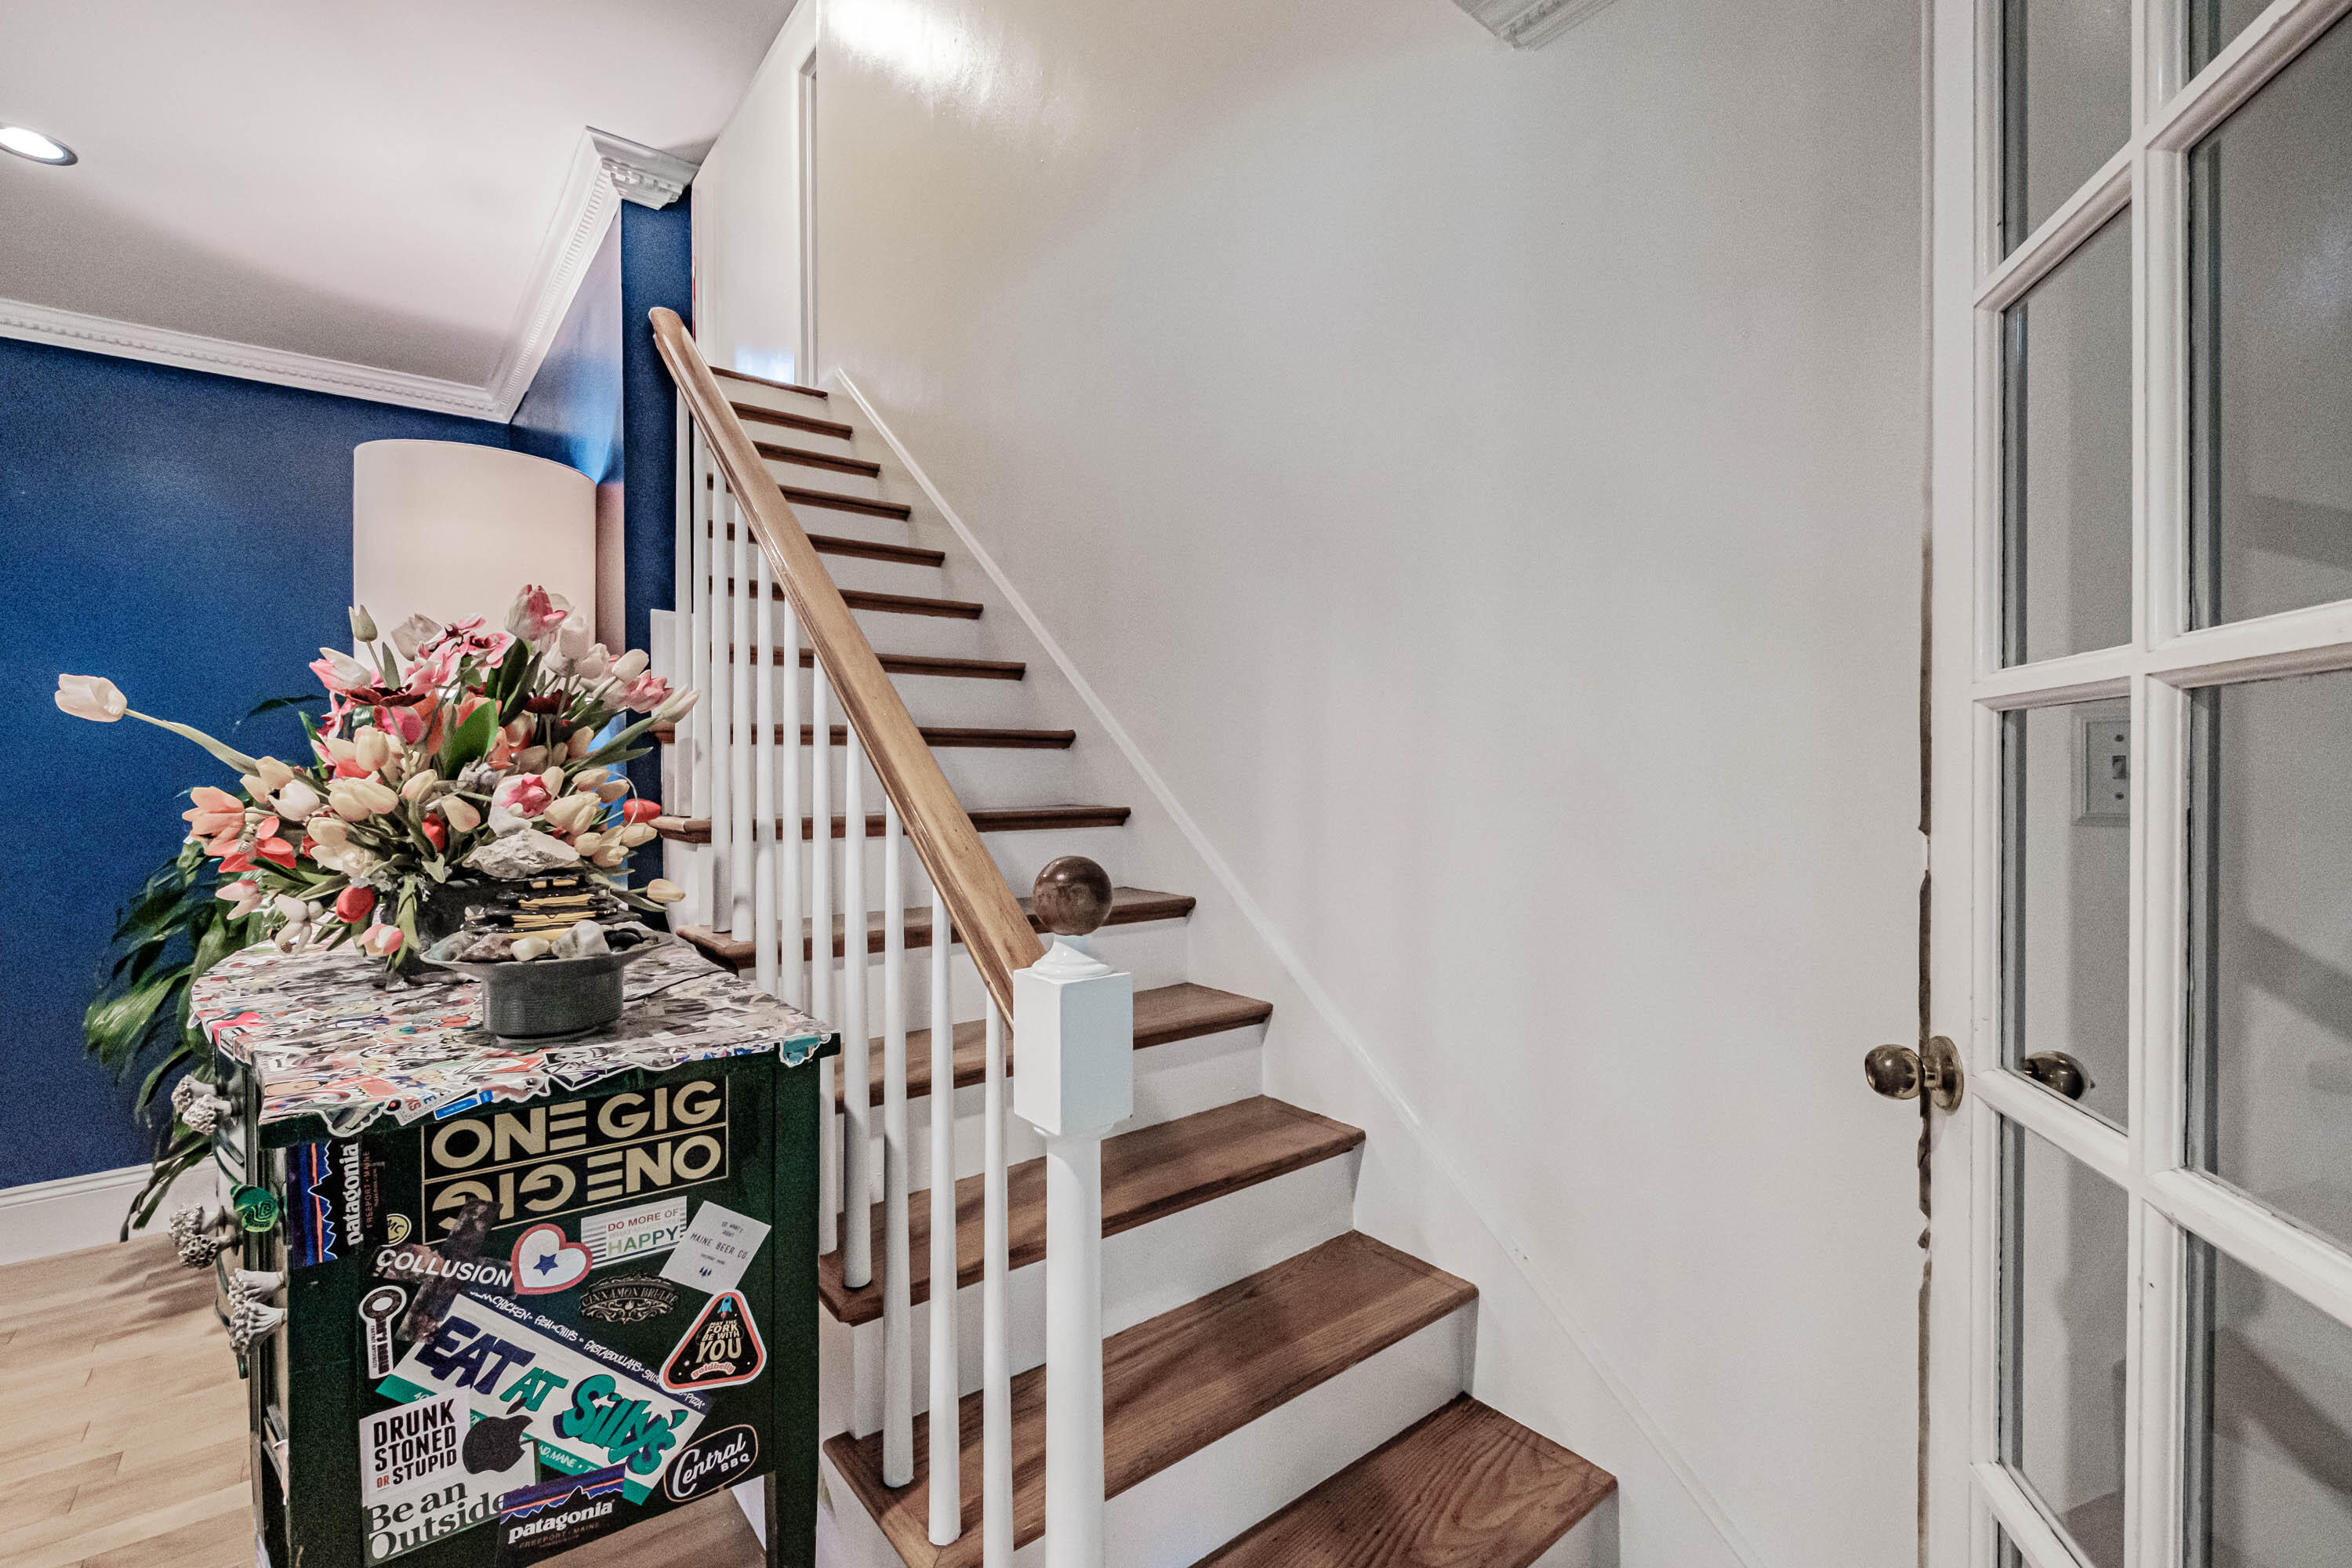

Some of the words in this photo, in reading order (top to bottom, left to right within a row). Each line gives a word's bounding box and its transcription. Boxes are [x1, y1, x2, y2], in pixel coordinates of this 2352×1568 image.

[432, 1100, 586, 1168] ONE
[597, 1080, 721, 1138] GIG
[586, 1134, 721, 1203] ONE
[339, 1142, 364, 1246] patagonia
[608, 1221, 625, 1232] DO
[628, 1212, 661, 1227] MORE
[664, 1208, 679, 1218] OF
[608, 1225, 679, 1256] HAPPY
[690, 1232, 713, 1247] MAINE
[715, 1242, 735, 1254] BEER
[737, 1250, 748, 1259] CO
[376, 1249, 513, 1287] COLLUSION
[582, 1287, 638, 1307] CINNAMON
[702, 1333, 714, 1341] BE
[717, 1330, 739, 1340] WITH
[706, 1323, 739, 1334] FORK
[414, 1315, 536, 1396] EAT
[499, 1367, 569, 1415] AT
[492, 1296, 530, 1320] CHICKEN
[641, 1369, 660, 1385] SHIS
[684, 1392, 703, 1410] PIZZA
[695, 1338, 742, 1363] YOU
[373, 1399, 456, 1448] DRUNK
[374, 1425, 456, 1472] STONED
[376, 1475, 390, 1488] OR
[393, 1449, 457, 1485] STUPID
[673, 1433, 746, 1497] Central
[720, 1453, 750, 1472] BBQ
[363, 1502, 414, 1534] Be
[420, 1483, 468, 1514] an
[508, 1501, 614, 1544] patagonia
